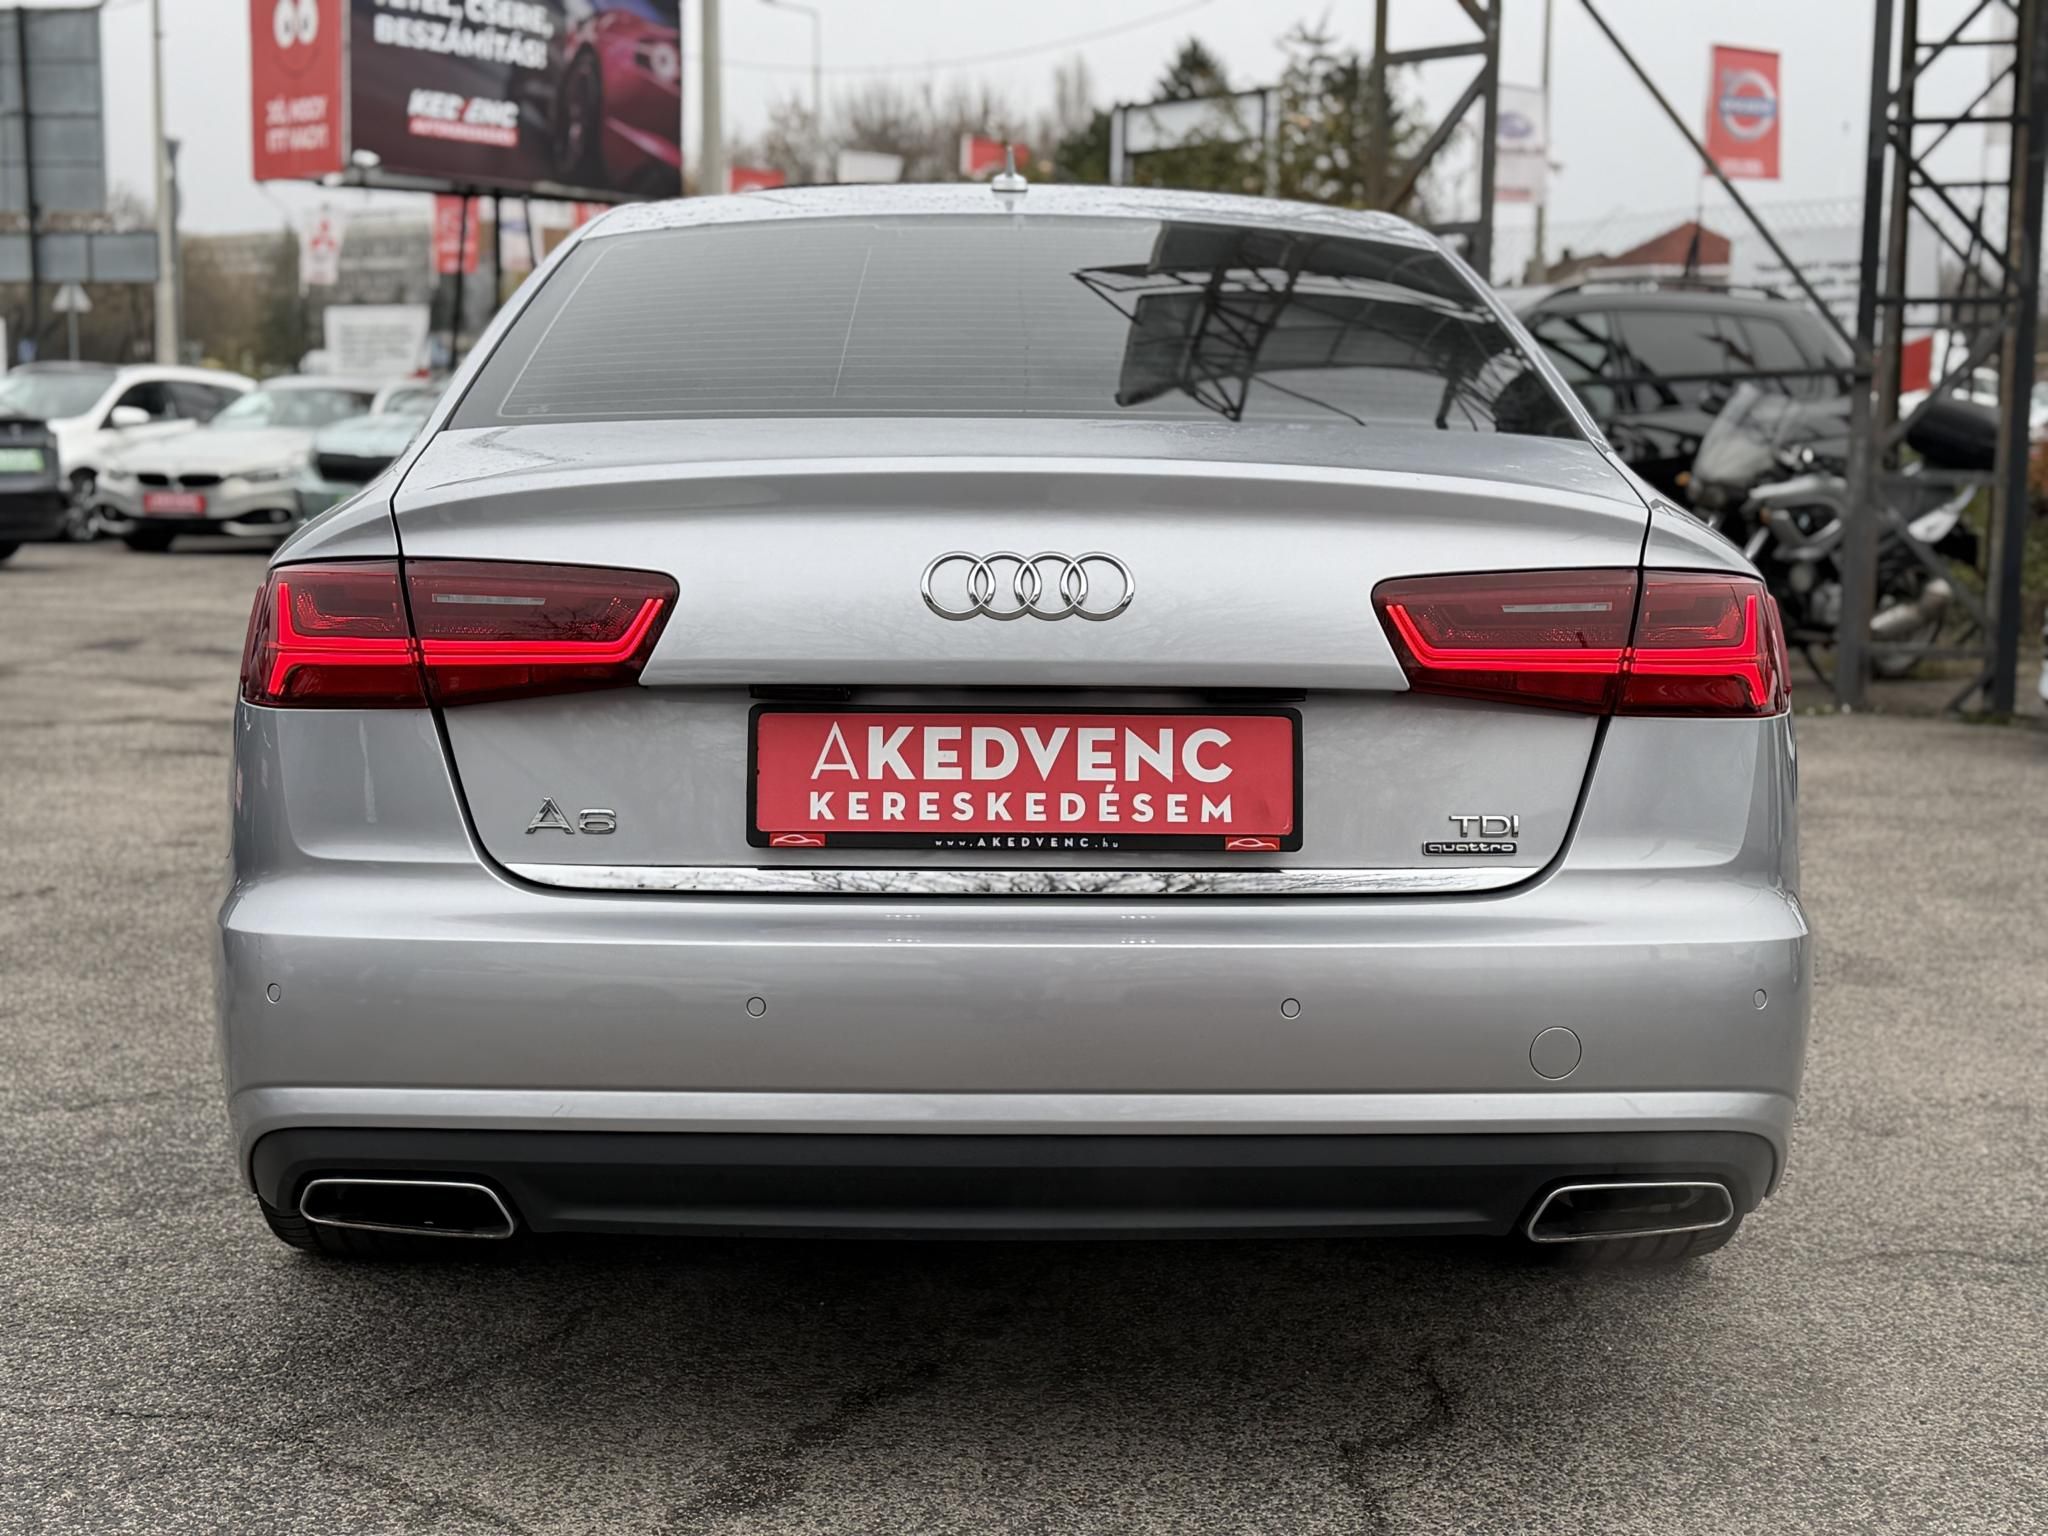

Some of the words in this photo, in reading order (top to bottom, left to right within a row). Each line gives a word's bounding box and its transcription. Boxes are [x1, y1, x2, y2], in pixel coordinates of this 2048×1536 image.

[809, 784, 1233, 824] KERESKEDÉSEM
[525, 797, 617, 835] A6
[1448, 815, 1519, 838] TDI
[935, 837, 1119, 848] www.AKEDVENC.hu
[1428, 843, 1514, 854] quattro
